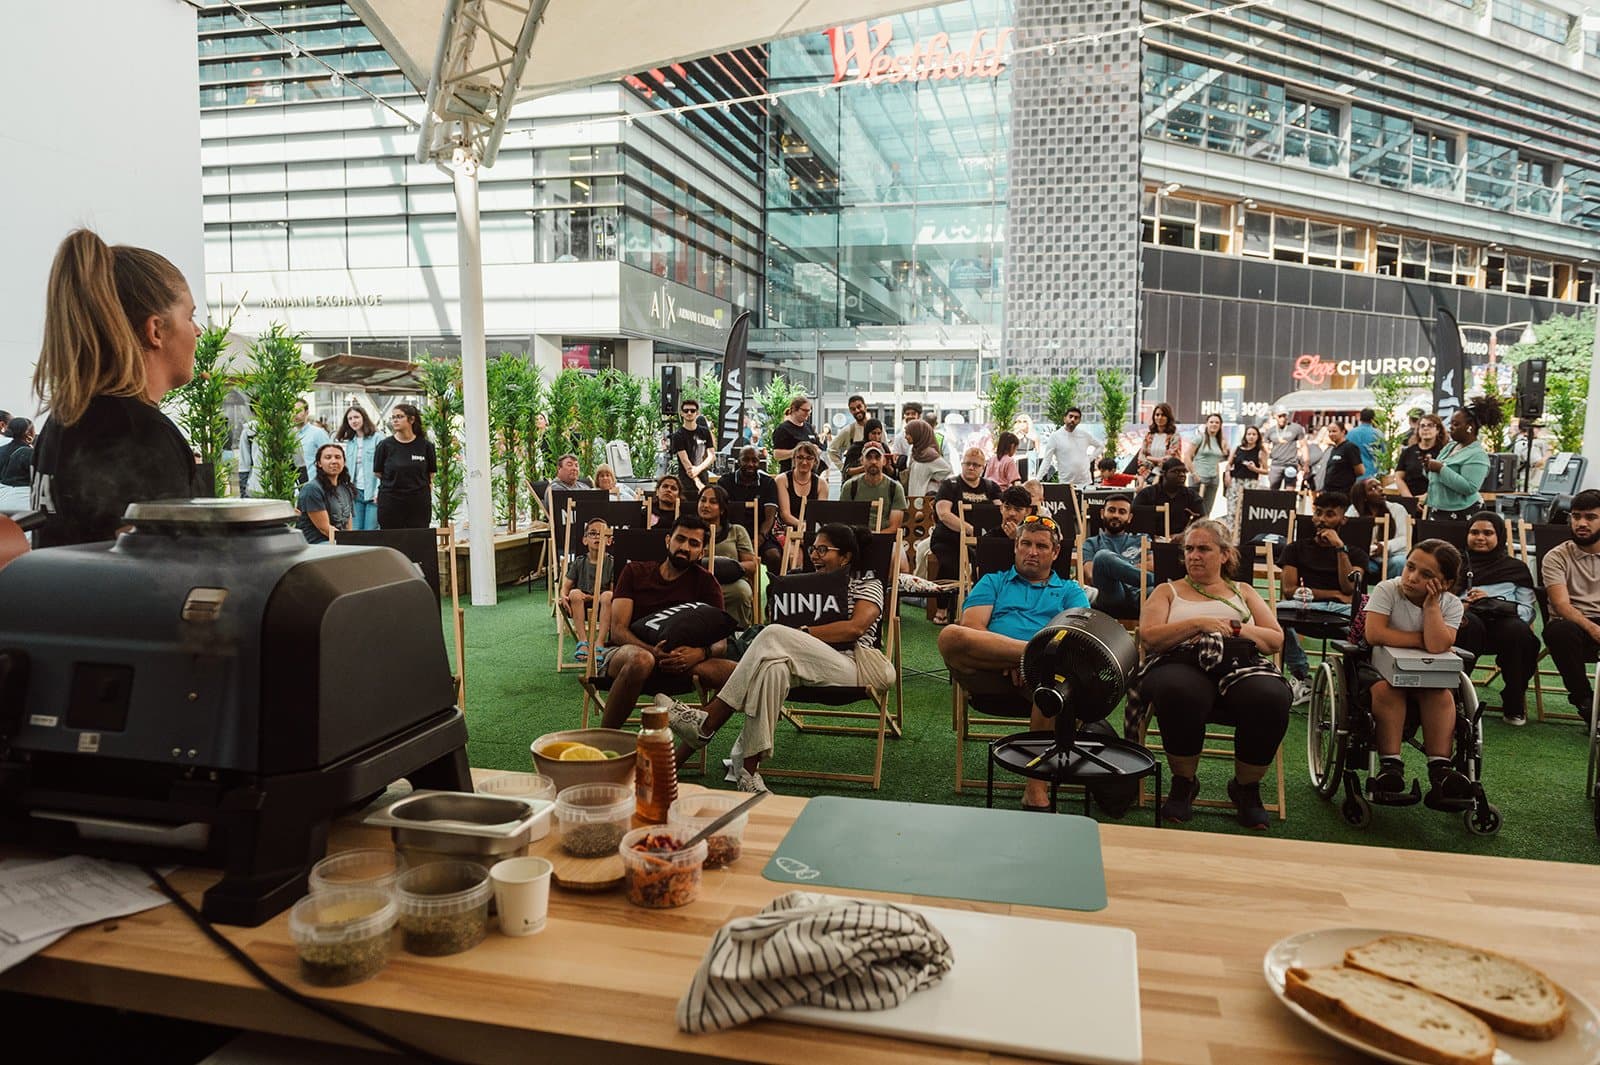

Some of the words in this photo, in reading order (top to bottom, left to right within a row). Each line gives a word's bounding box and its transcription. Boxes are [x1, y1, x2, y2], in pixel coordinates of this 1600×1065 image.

[822, 20, 1014, 85] Westfield
[315, 294, 383, 308] EXCHANGE
[720, 367, 744, 456] NINJA
[1248, 505, 1288, 524] NINJA
[773, 592, 841, 622] NINJA
